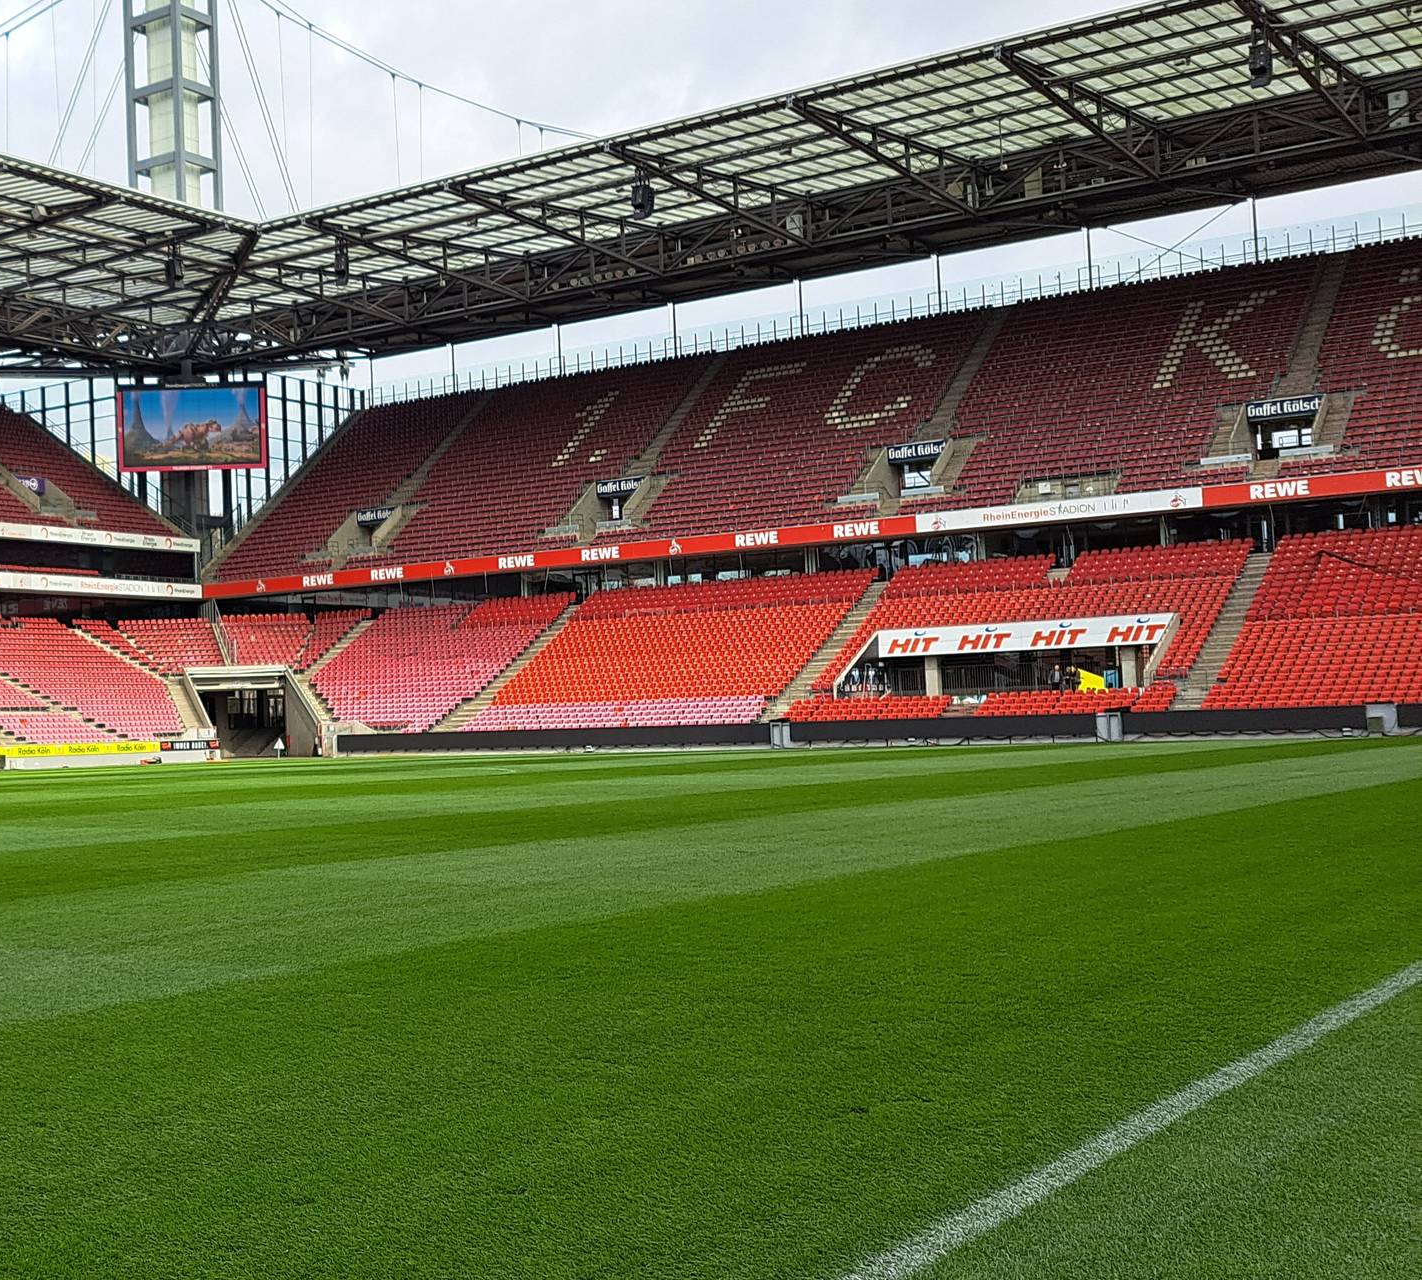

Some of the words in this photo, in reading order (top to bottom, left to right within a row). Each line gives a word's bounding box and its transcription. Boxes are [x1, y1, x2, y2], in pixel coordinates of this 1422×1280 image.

[1247, 401, 1283, 417] Gaffel
[888, 448, 916, 460] Gaffel
[1385, 471, 1422, 488] RE
[1249, 480, 1310, 500] REWE
[833, 521, 880, 539] REWE
[735, 531, 779, 548] REWE
[498, 554, 535, 569] REWE
[581, 546, 620, 561] REWE
[303, 573, 334, 588] REWE
[370, 567, 404, 581] REWE
[957, 632, 1012, 651] HIT
[1030, 627, 1088, 647] HIT
[1105, 623, 1167, 643] HIT
[887, 636, 940, 654] HIT
